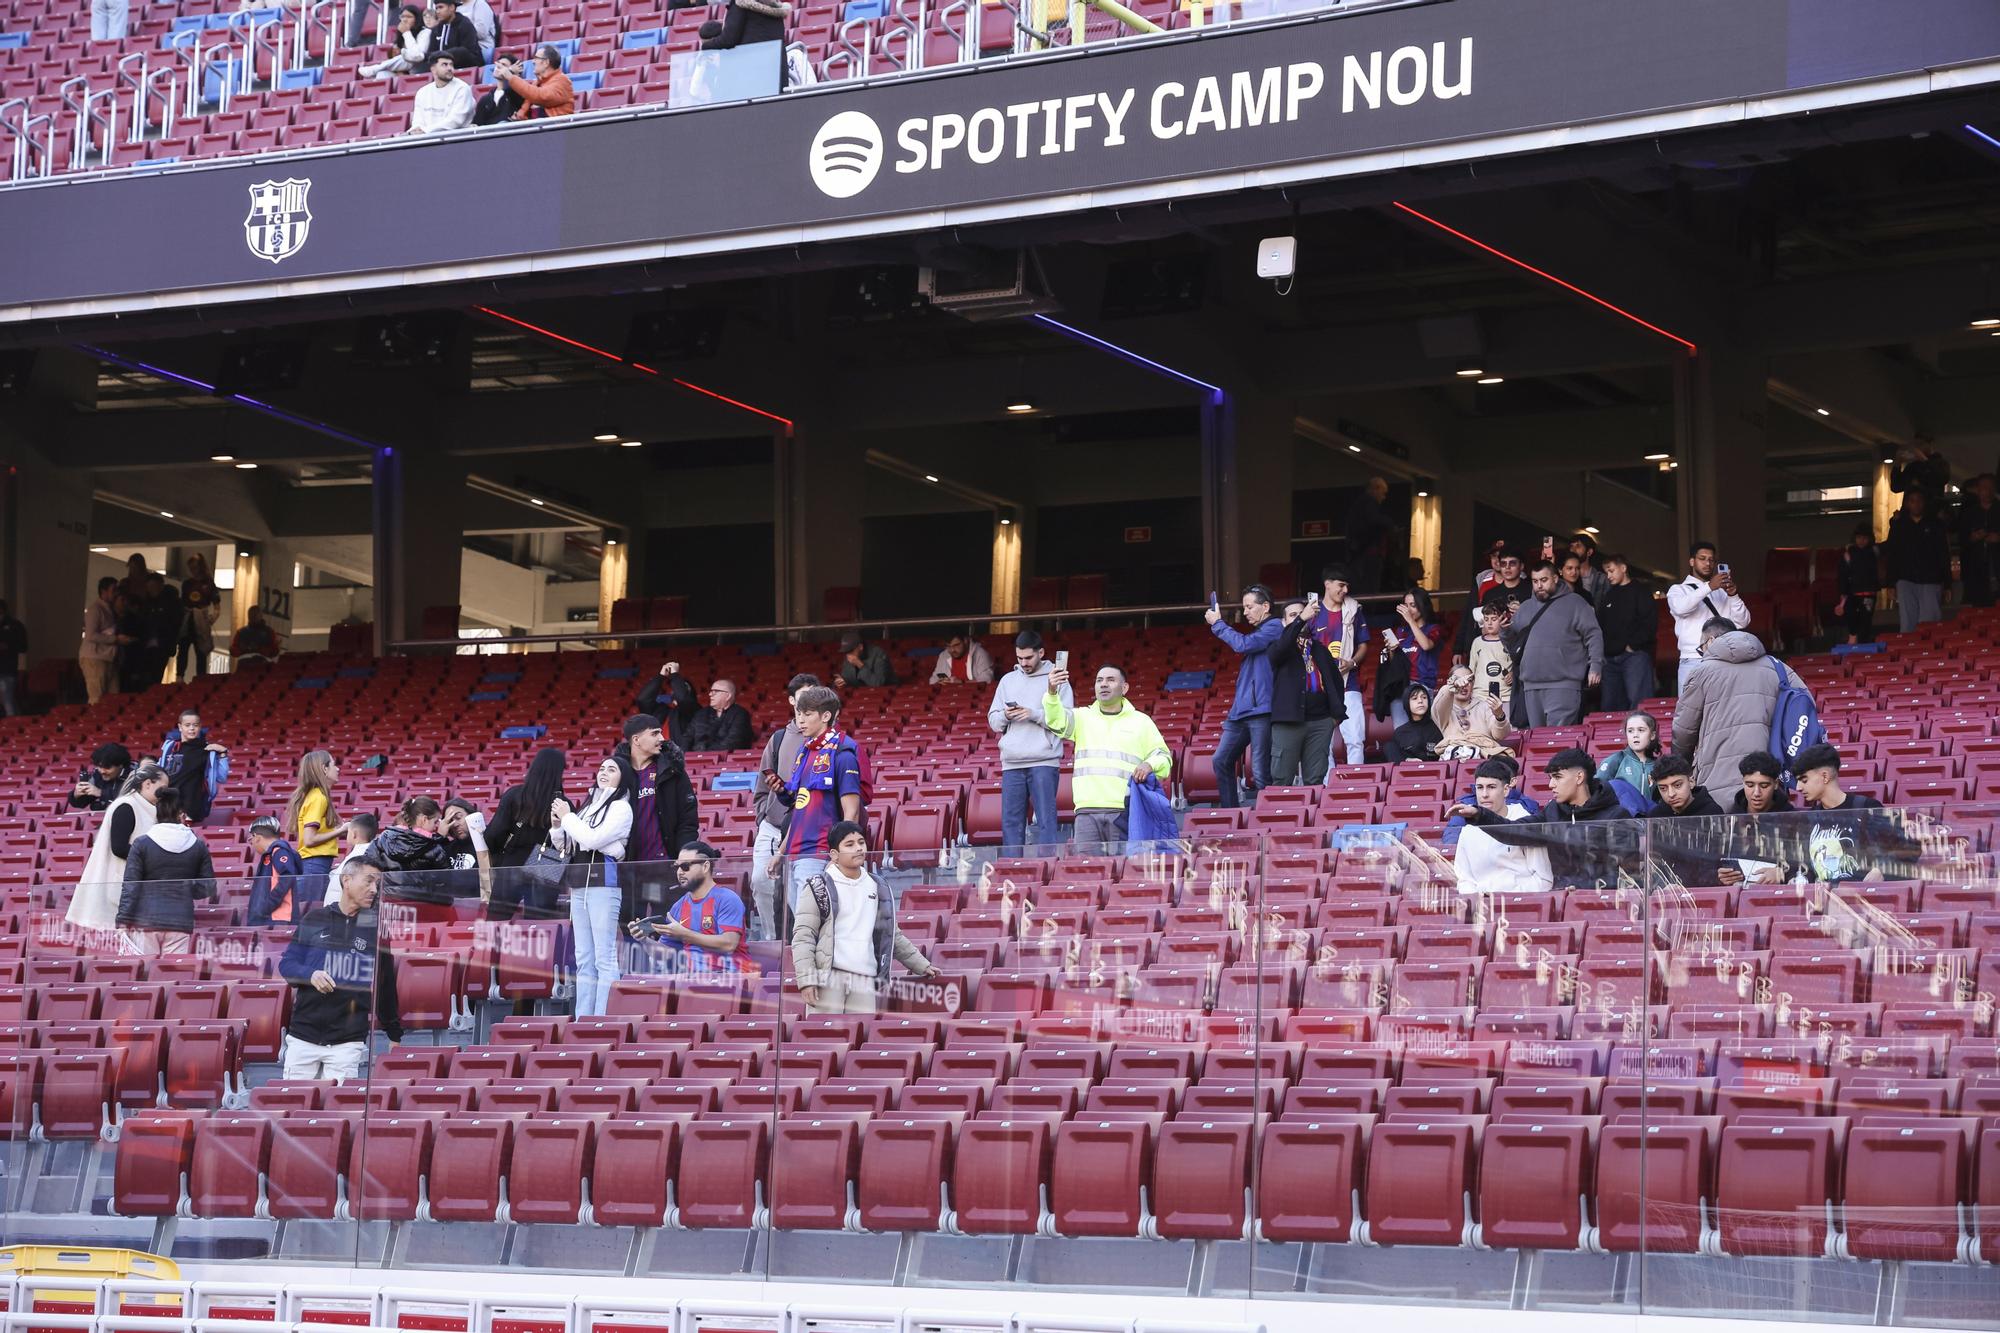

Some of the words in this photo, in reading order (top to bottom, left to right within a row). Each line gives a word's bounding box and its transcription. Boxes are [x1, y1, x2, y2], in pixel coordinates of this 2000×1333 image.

[896, 87, 1135, 173] SPOTIFY
[1150, 61, 1325, 140] CAMP
[1342, 37, 1473, 113] NOU
[265, 213, 291, 226] FCB
[262, 586, 290, 620] 121
